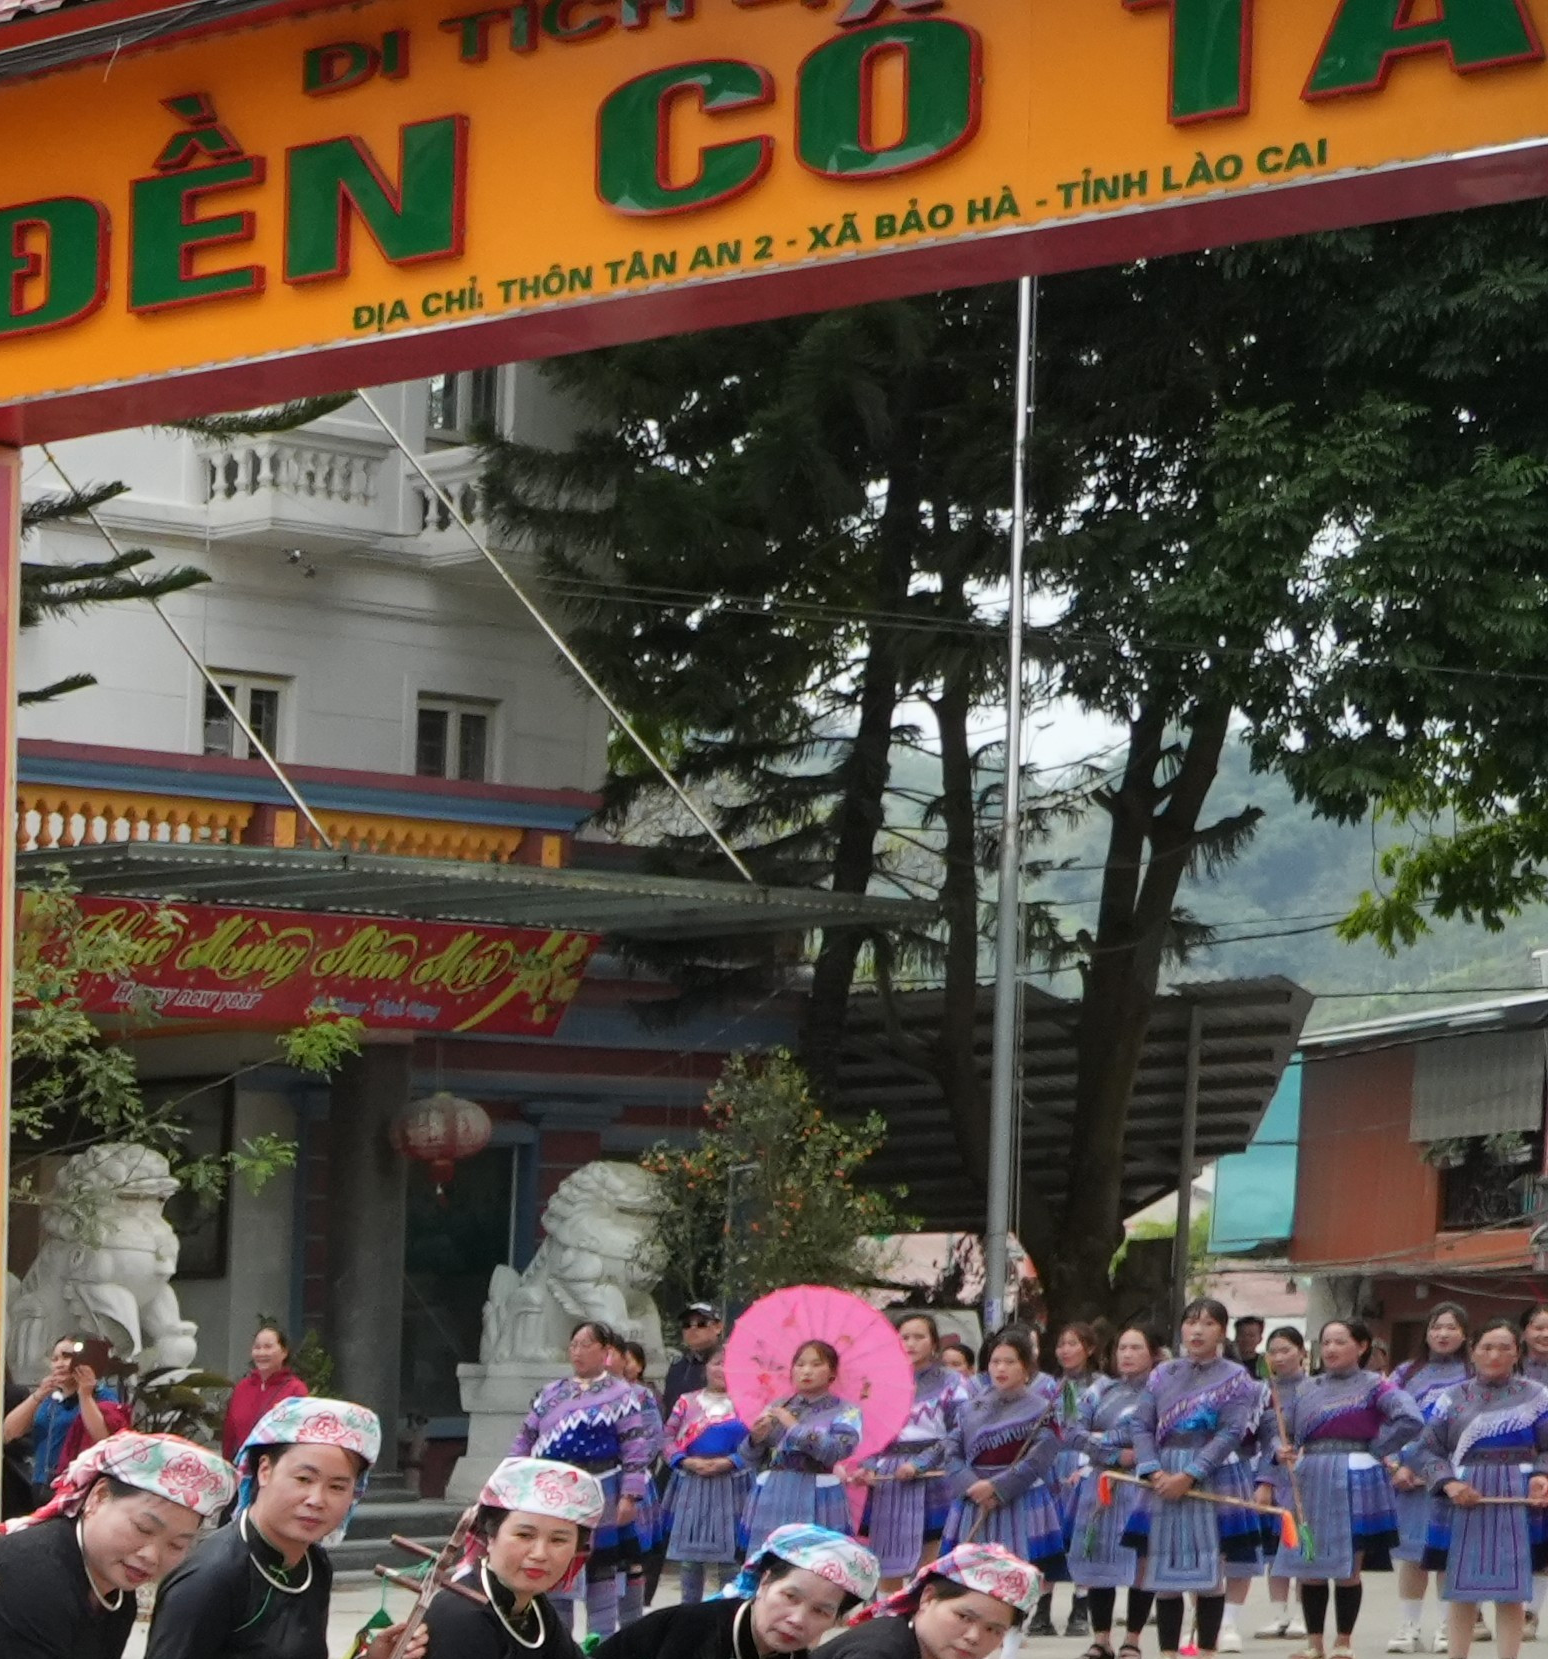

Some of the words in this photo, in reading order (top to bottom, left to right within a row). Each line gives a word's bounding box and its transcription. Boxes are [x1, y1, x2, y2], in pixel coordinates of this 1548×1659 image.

[303, 27, 409, 97] DI
[594, 0, 983, 217] CÔ
[352, 297, 409, 333] ĐỊA
[497, 262, 594, 306] THÔN
[604, 246, 677, 290] TÂN
[687, 238, 743, 276] AN
[754, 234, 773, 262] 2
[806, 209, 863, 256] XÃ
[874, 196, 954, 238] BẢO
[966, 184, 1021, 225] HÀ
[1056, 165, 1148, 210] TỈNH
[1160, 148, 1244, 197] LÀO
[1256, 139, 1328, 177] CAI
